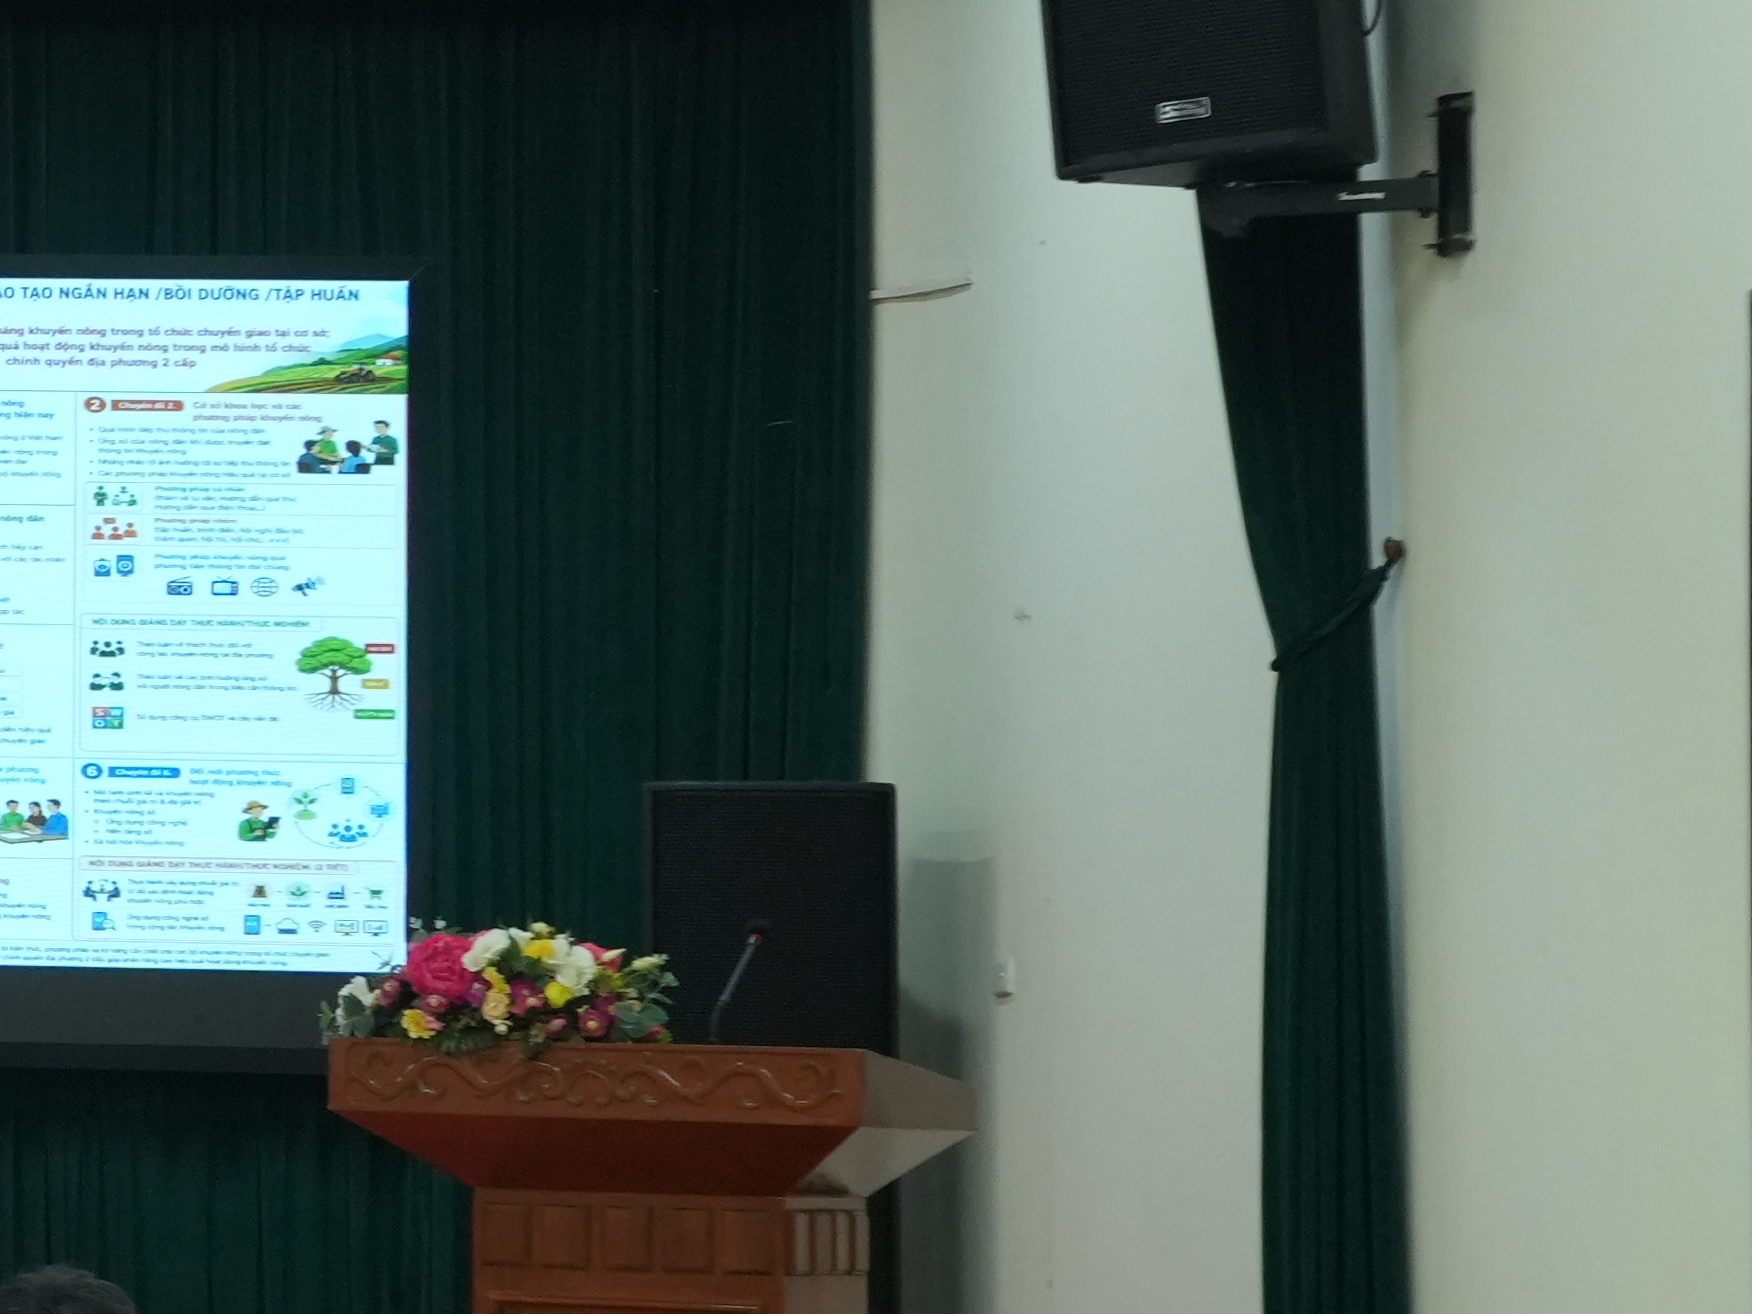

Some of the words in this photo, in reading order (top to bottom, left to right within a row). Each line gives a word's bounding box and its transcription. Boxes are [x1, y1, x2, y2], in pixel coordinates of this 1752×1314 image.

[19, 287, 53, 301] TẠO
[58, 283, 107, 300] NGẮN
[112, 287, 149, 302] HẠN
[197, 285, 259, 301] DƯỠNG
[309, 285, 359, 301] HUẤN
[75, 327, 107, 338] nông
[109, 328, 145, 338] trong
[163, 327, 194, 337] chức
[243, 328, 271, 339] giao
[273, 328, 291, 338] tại
[21, 341, 51, 352] hoạt
[53, 341, 86, 353] động
[136, 342, 169, 354] nông
[171, 343, 207, 354] trong
[4, 356, 41, 366] chính
[85, 357, 106, 368] địa
[109, 358, 158, 369] phương
[161, 358, 170, 367] 2
[173, 357, 197, 369] cấp
